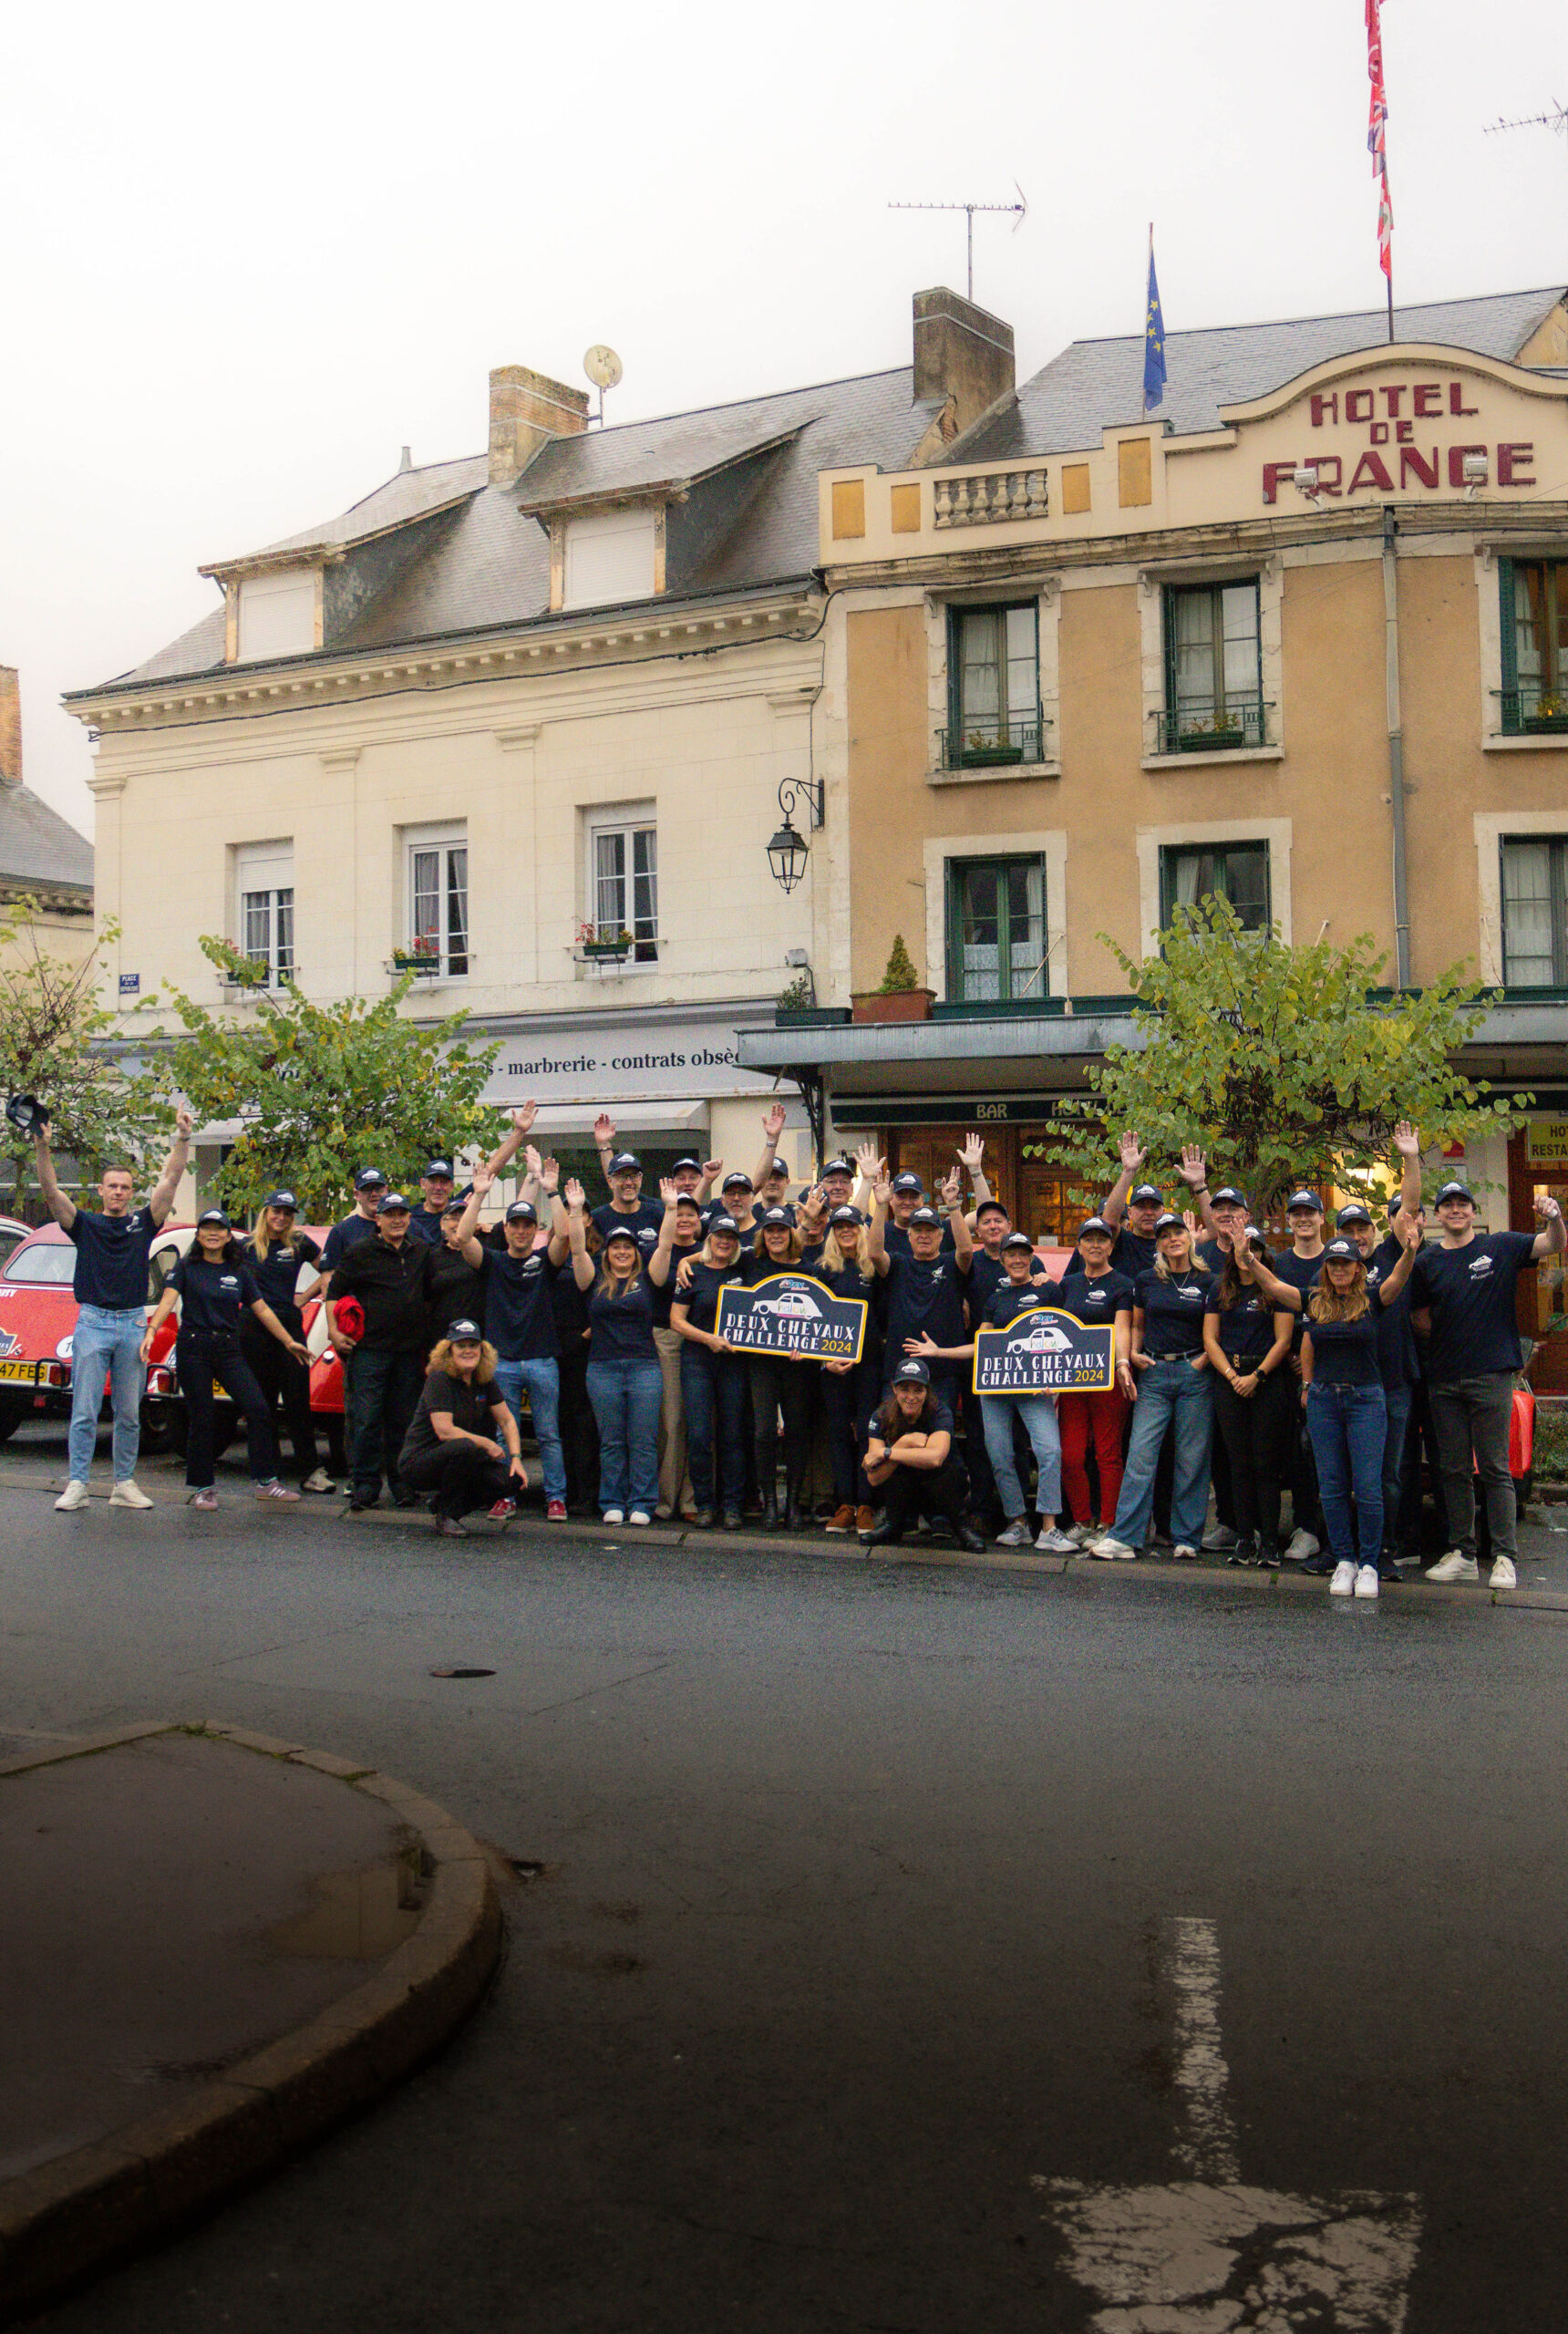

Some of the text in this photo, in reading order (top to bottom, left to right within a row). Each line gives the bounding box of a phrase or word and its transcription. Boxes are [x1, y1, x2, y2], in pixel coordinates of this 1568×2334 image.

[1310, 382, 1479, 427] HOTEL
[1369, 420, 1414, 445] DE
[1263, 442, 1536, 504] FRANCE
[508, 1055, 596, 1075] marbrerie
[612, 1052, 686, 1070] contrats
[691, 1048, 739, 1066] obsè
[976, 1104, 1007, 1120] BAR
[1551, 1125, 1568, 1138] HO
[1532, 1143, 1568, 1156] RESTA
[726, 1313, 855, 1341] DEUX CHEVAUX
[723, 1328, 851, 1353] CHALLENGE 2024
[984, 1353, 1105, 1371] DEUX CHEVAUX
[981, 1369, 1104, 1385] CHALLENGE 2024
